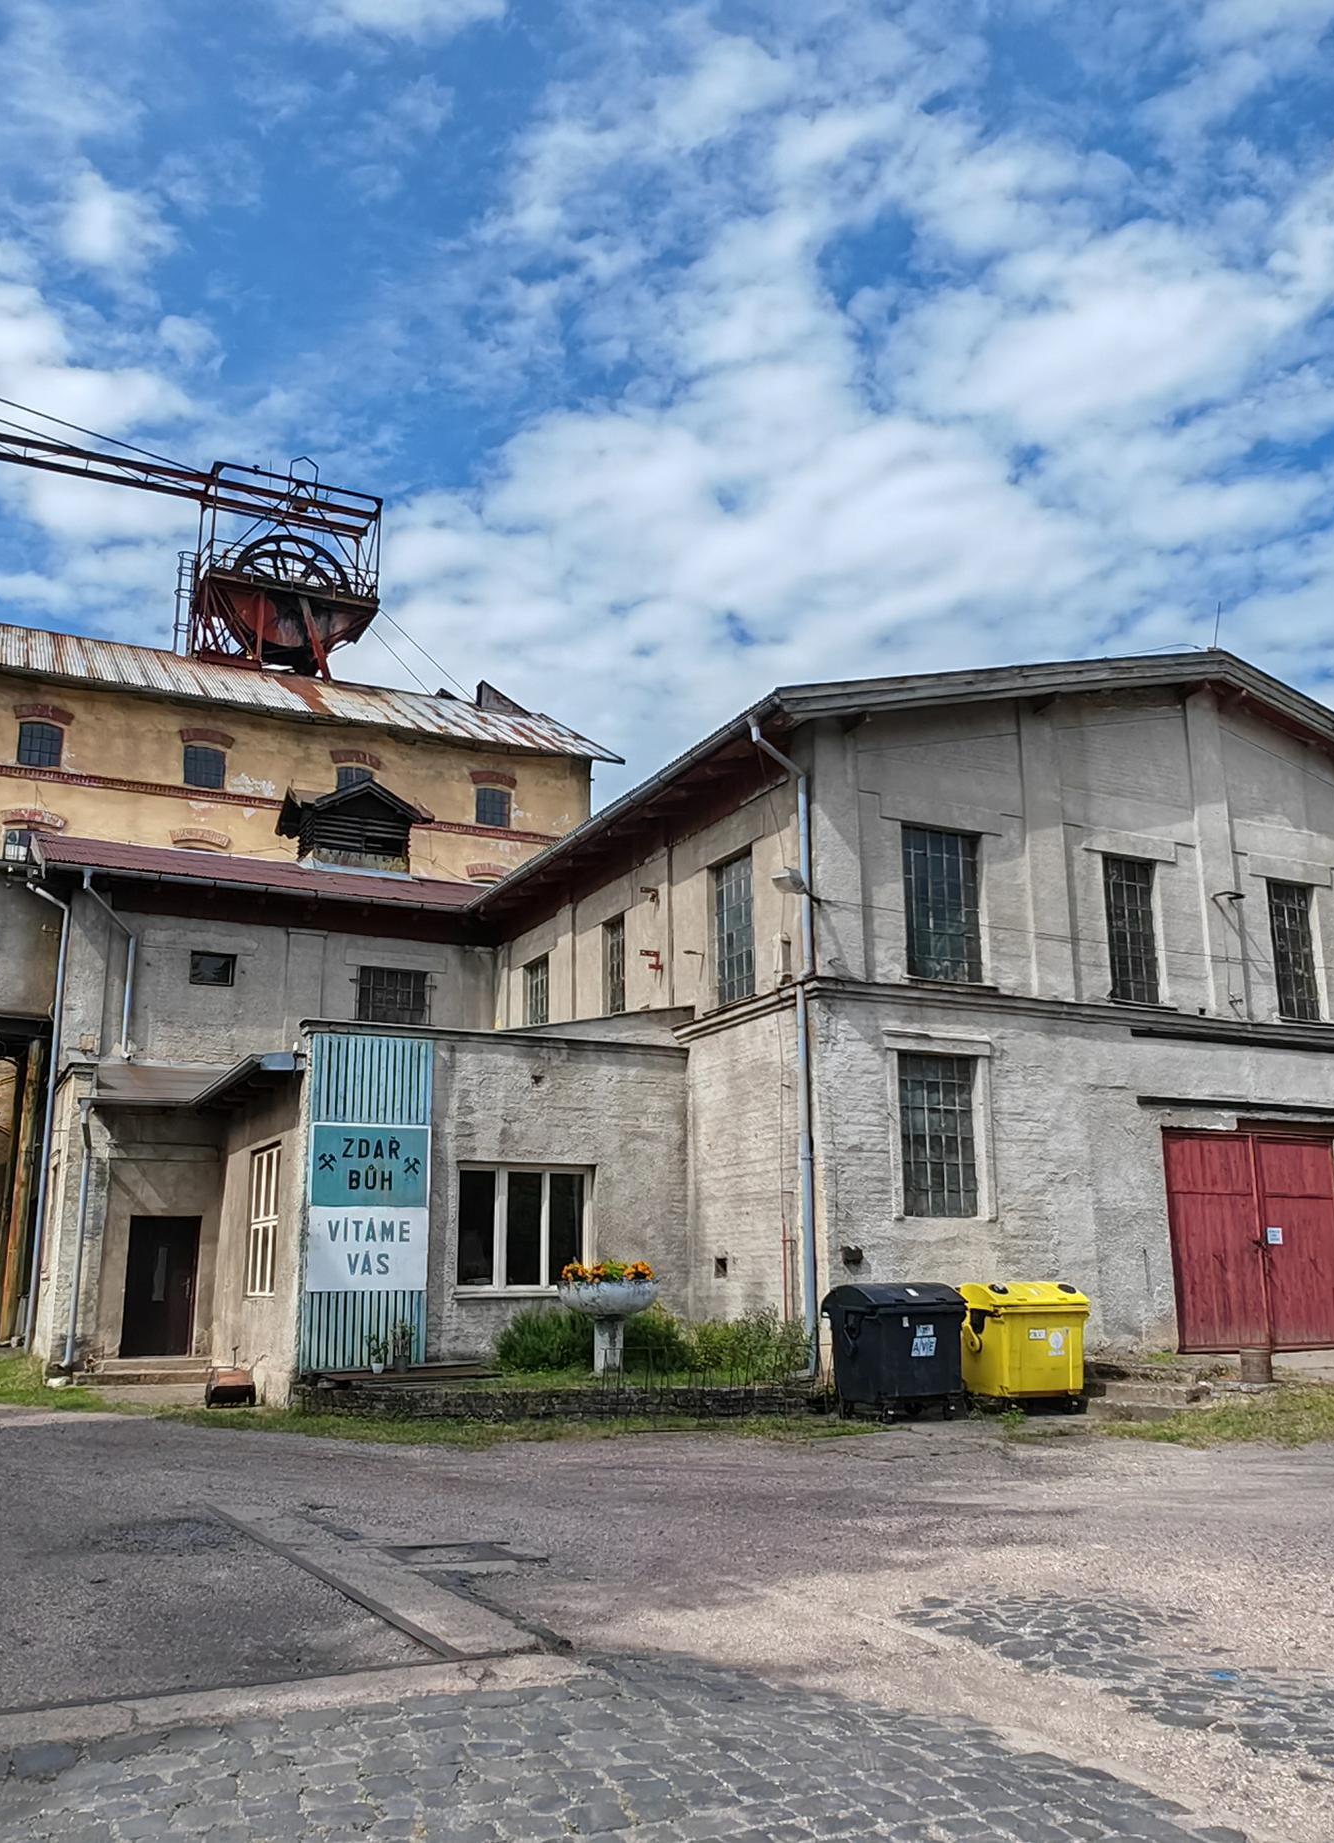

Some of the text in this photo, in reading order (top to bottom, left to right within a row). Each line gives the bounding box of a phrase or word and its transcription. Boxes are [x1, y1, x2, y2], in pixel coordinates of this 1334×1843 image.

[342, 1136, 401, 1160] ZDAŘ
[348, 1164, 393, 1191] BŮH
[327, 1217, 411, 1242] VÍTÁME
[347, 1250, 390, 1275] VÁS
